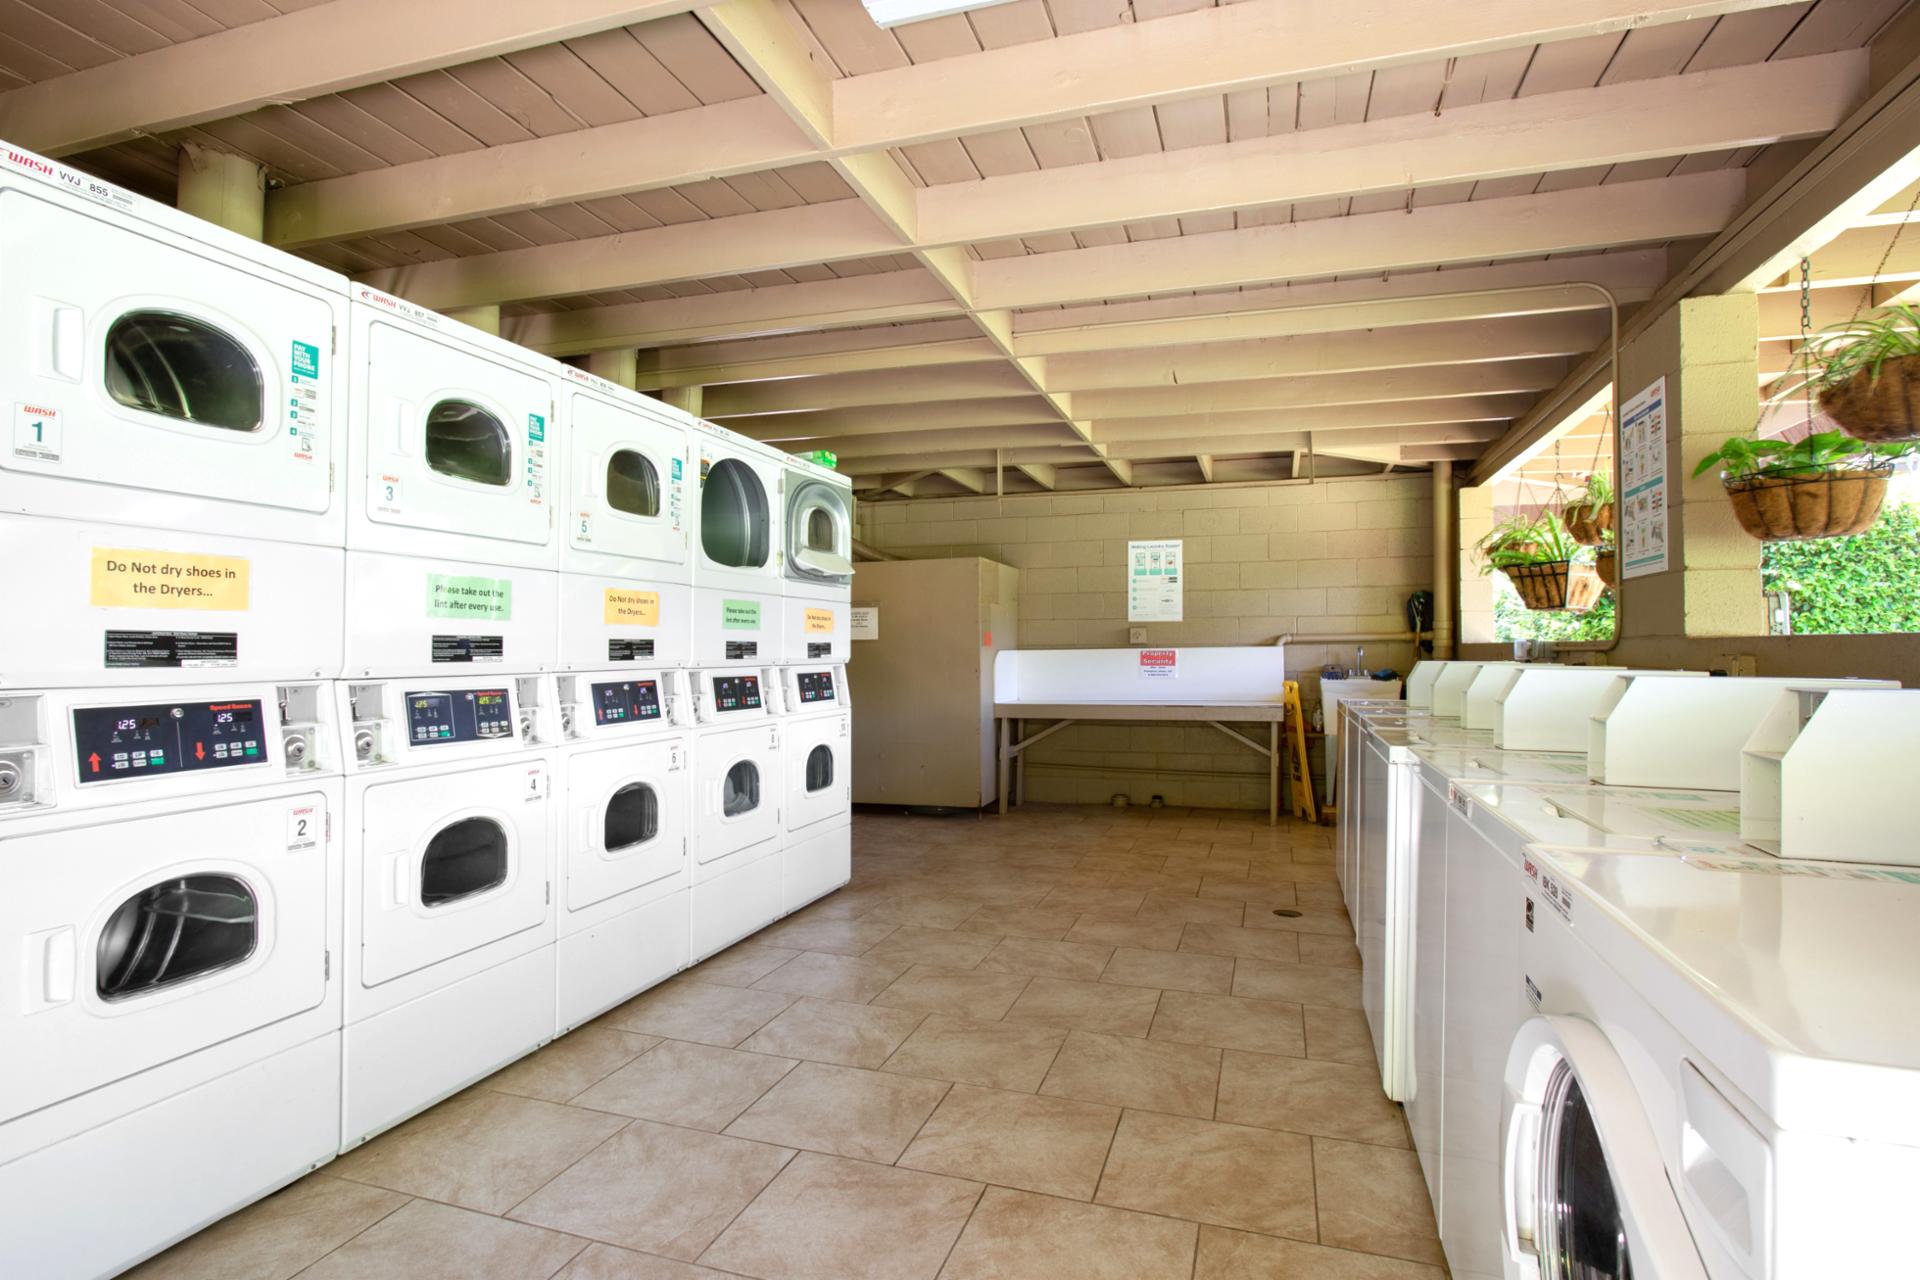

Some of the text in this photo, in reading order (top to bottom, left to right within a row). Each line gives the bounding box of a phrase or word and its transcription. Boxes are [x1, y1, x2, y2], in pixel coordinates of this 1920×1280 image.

[8, 151, 109, 197] WASH VVJ 855
[373, 294, 397, 309] WASH
[23, 405, 56, 418] WASH
[32, 421, 43, 443] 1
[386, 485, 394, 502] 3
[581, 520, 588, 533] 5
[106, 560, 236, 579] Do Not dry shoes in
[133, 582, 213, 598] the Dryers...
[435, 584, 504, 598] Please take out the
[434, 599, 448, 608] lint
[449, 600, 467, 609] after
[468, 602, 488, 612] every
[609, 595, 617, 603] Do
[530, 778, 536, 791] 4
[297, 819, 307, 836] 2
[1523, 859, 1538, 880] WASH
